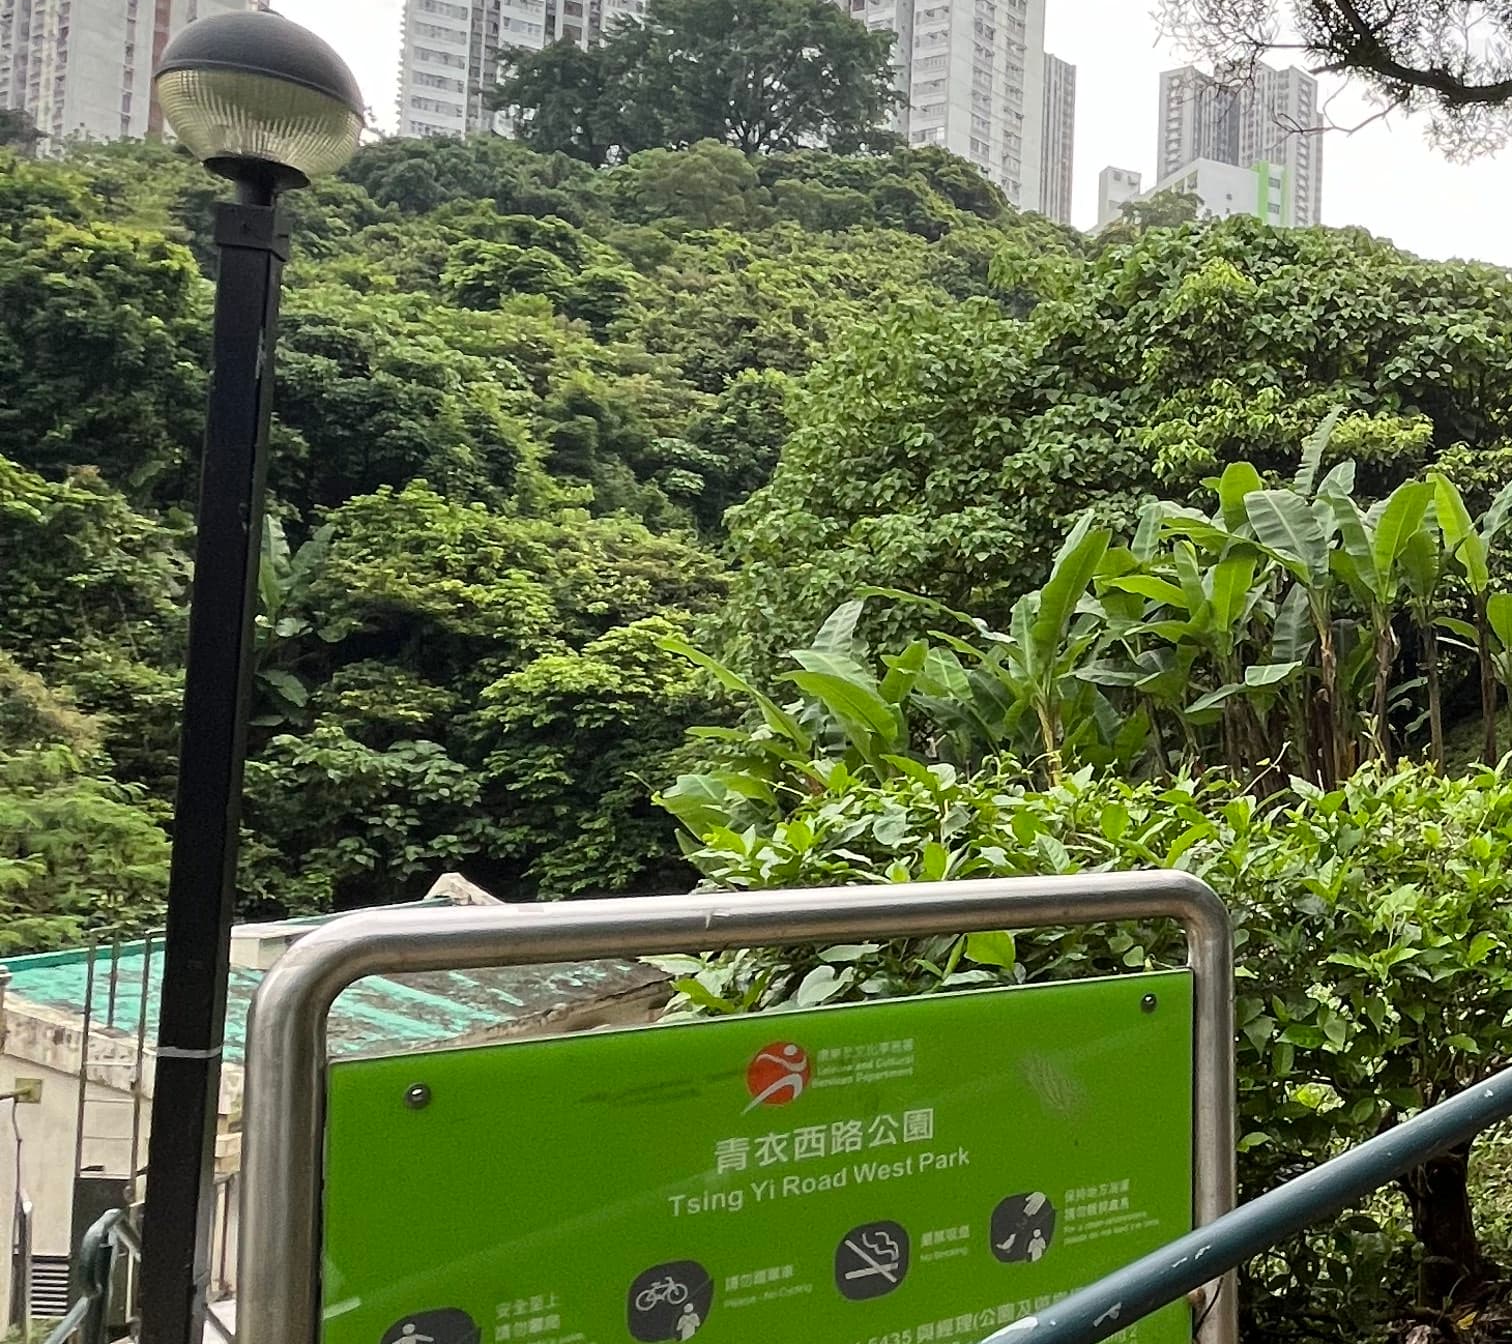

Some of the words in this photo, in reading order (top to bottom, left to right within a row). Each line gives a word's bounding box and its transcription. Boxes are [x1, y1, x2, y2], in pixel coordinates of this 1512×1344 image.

[714, 1108, 934, 1174] 青衣西路公園
[668, 1189, 744, 1217] Tsing
[750, 1177, 775, 1202] Yi
[783, 1168, 847, 1197] Road
[853, 1157, 913, 1183] West
[919, 1146, 970, 1173] Park
